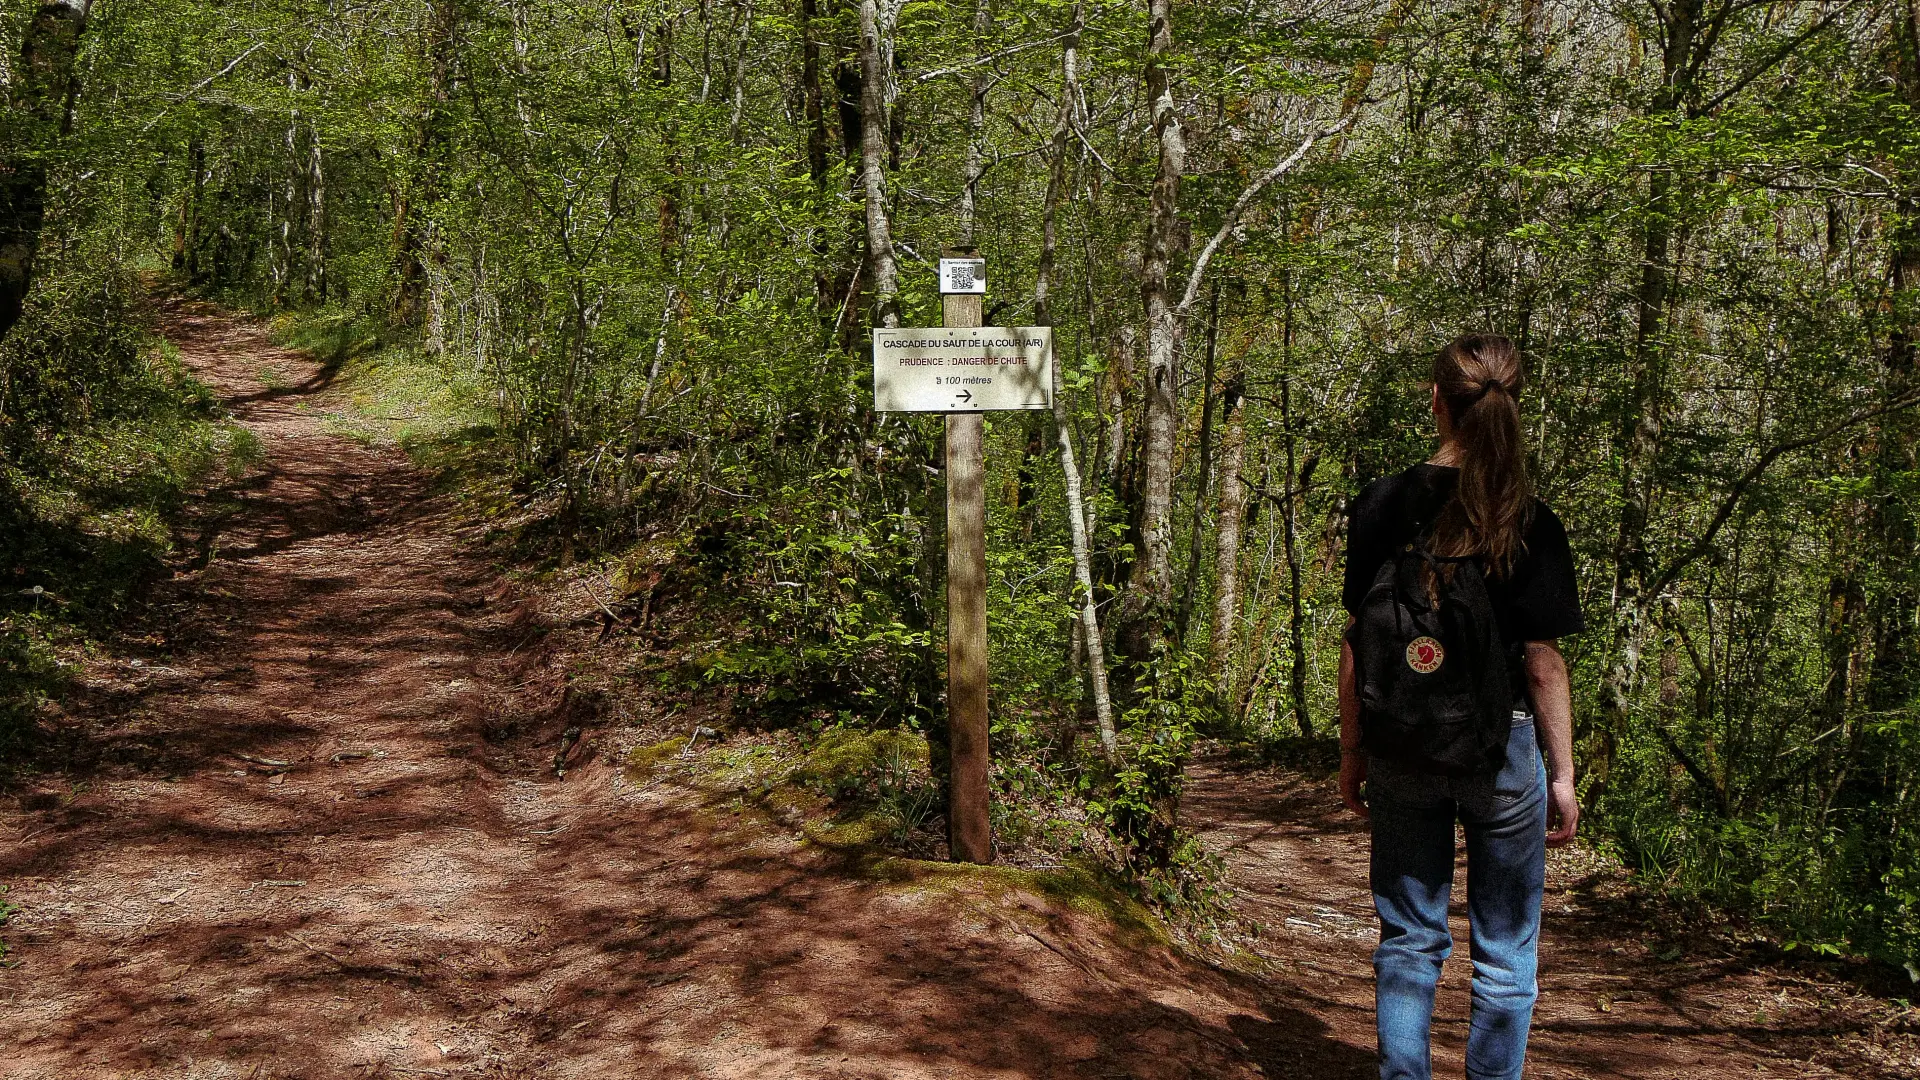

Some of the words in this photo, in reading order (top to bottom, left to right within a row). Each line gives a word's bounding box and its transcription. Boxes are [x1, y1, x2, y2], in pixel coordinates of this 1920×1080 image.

[883, 340, 927, 348] CASCADE
[928, 340, 941, 348] DU
[943, 340, 967, 348] SAUT
[995, 339, 1021, 347] COUR
[1024, 339, 1043, 348] (A/R)
[899, 358, 943, 366] PRUDENCE
[952, 357, 986, 366] DANGER
[987, 357, 999, 365] DE
[1001, 357, 1028, 365] CHUTE
[945, 376, 961, 385] 100
[962, 375, 992, 385] mètres
